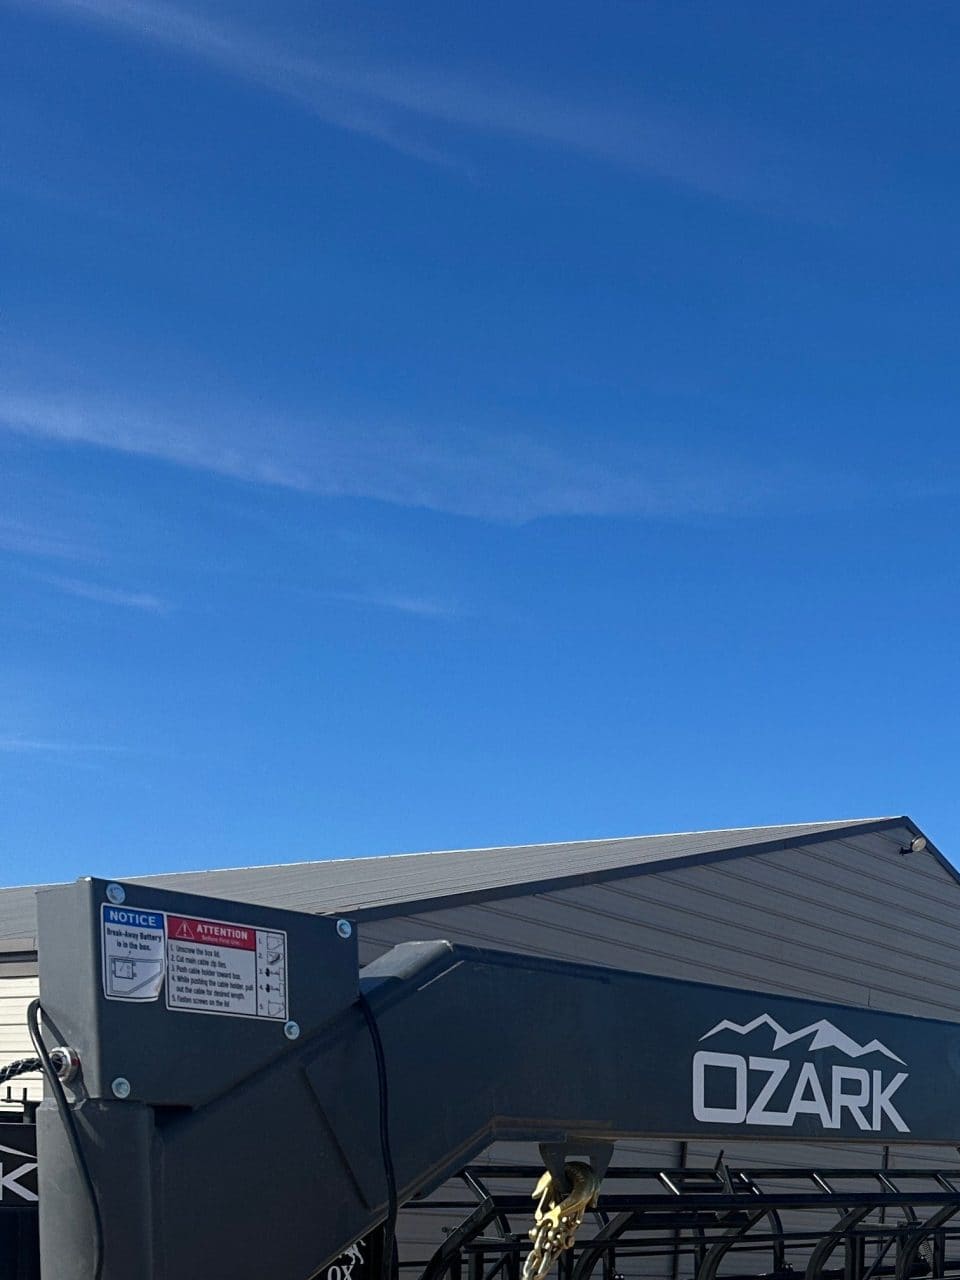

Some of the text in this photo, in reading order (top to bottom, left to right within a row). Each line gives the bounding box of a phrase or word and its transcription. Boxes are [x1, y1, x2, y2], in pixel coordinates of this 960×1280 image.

[109, 910, 156, 926] NOTICE
[106, 928, 161, 943] Break-Away Battery
[196, 924, 248, 940] ATTENTION
[176, 945, 195, 954] Unscrew
[176, 955, 184, 963] Cut
[176, 965, 187, 973] Push
[201, 968, 215, 976] holder
[177, 975, 189, 983] While
[191, 978, 208, 987] pushing
[177, 995, 192, 1003] Fasten
[692, 1050, 911, 1133] OZARK
